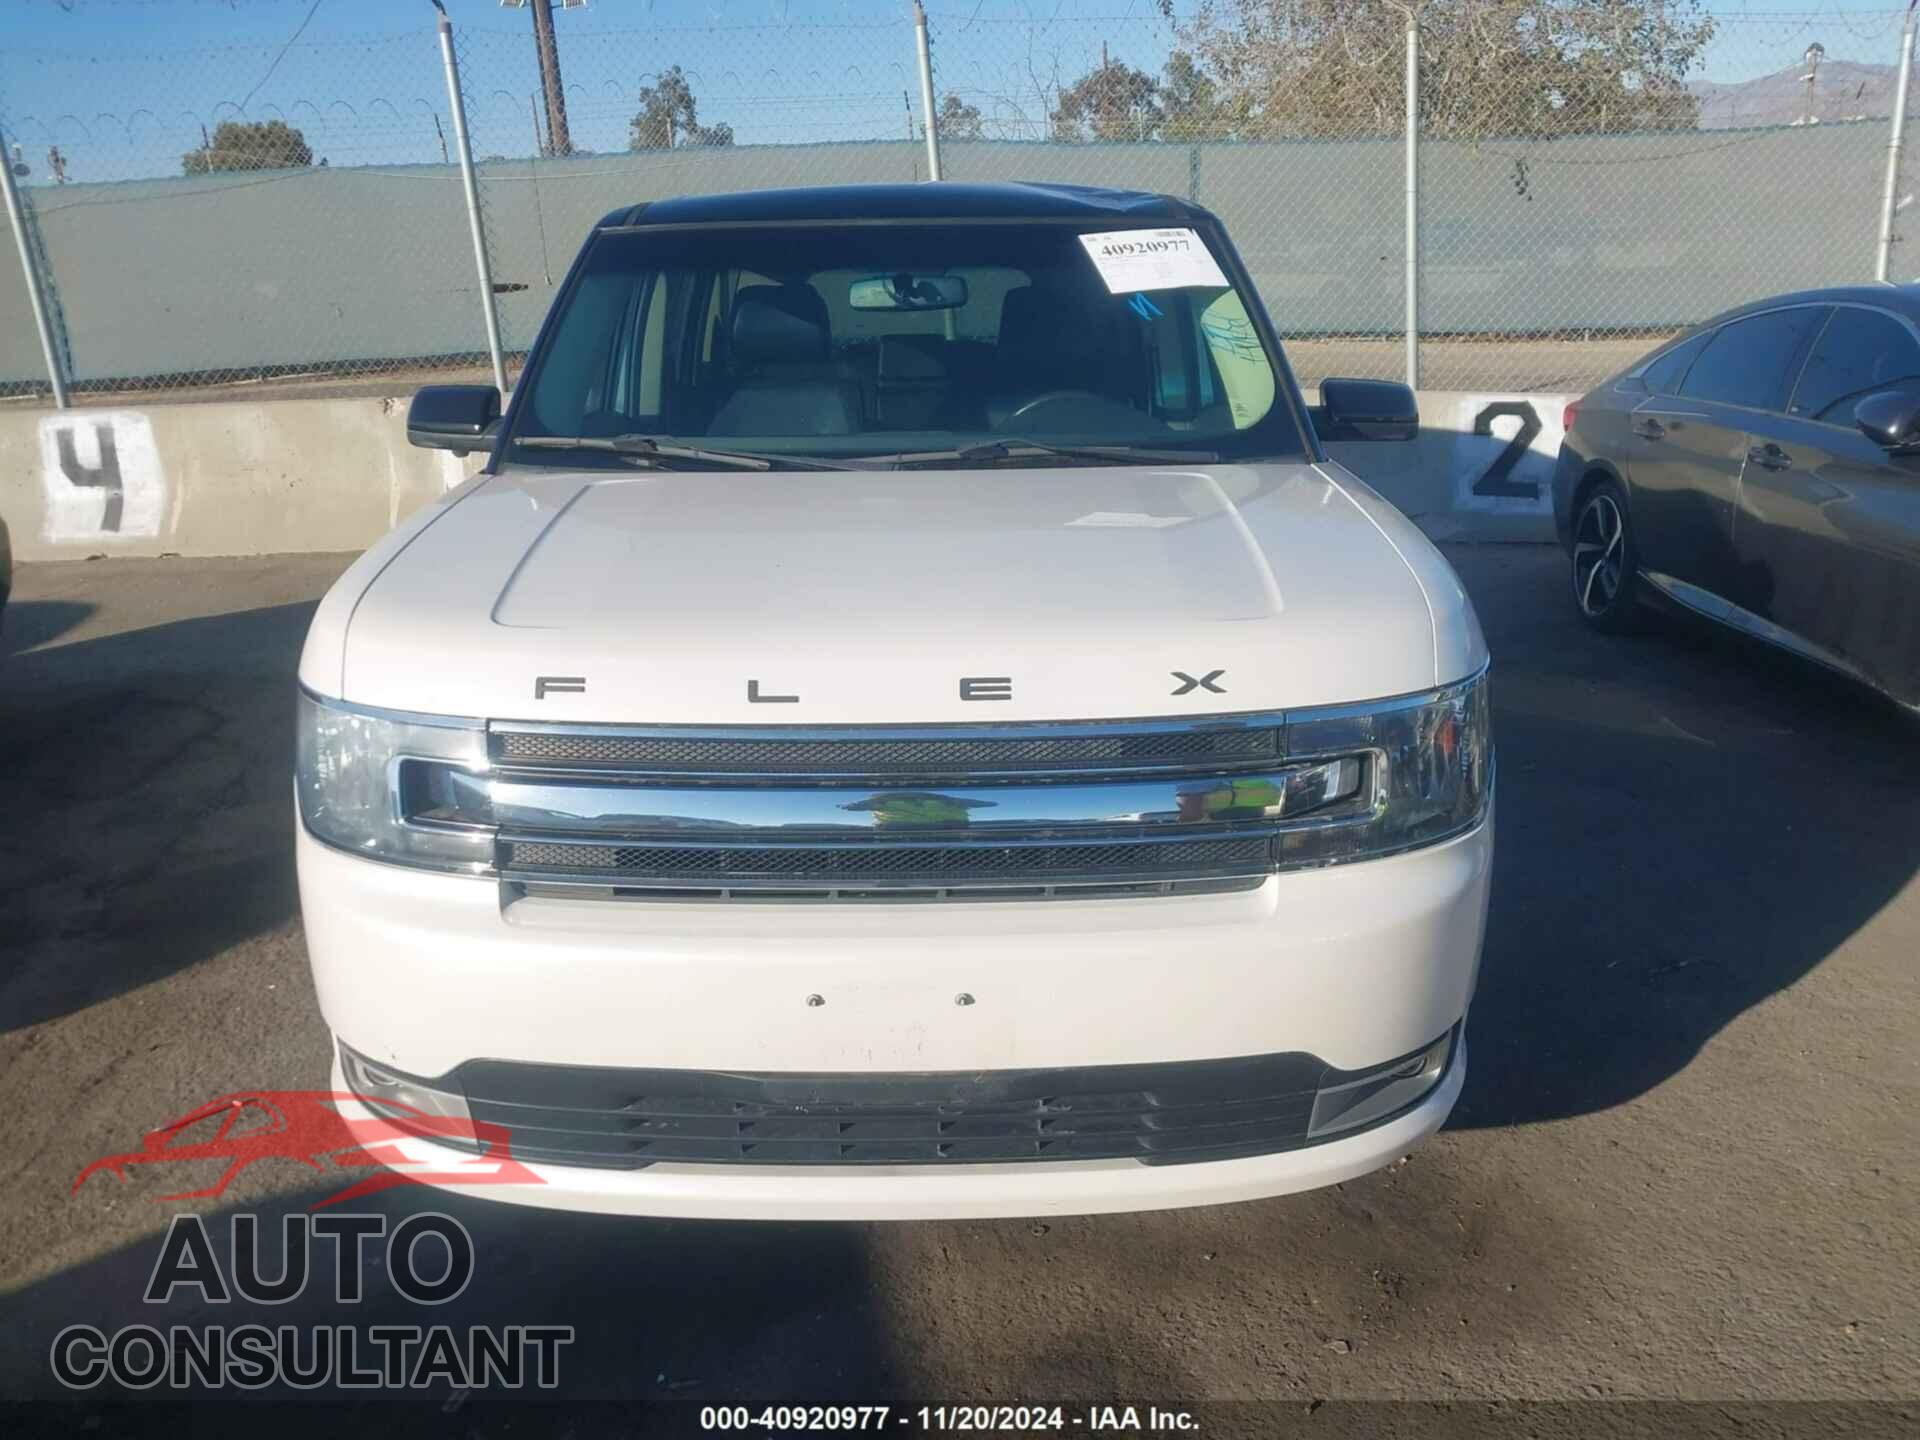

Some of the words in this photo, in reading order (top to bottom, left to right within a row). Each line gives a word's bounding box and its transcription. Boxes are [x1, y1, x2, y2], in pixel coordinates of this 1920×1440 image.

[1101, 239, 1190, 257] 40920977
[56, 425, 124, 533] 4
[1472, 400, 1543, 500] 2
